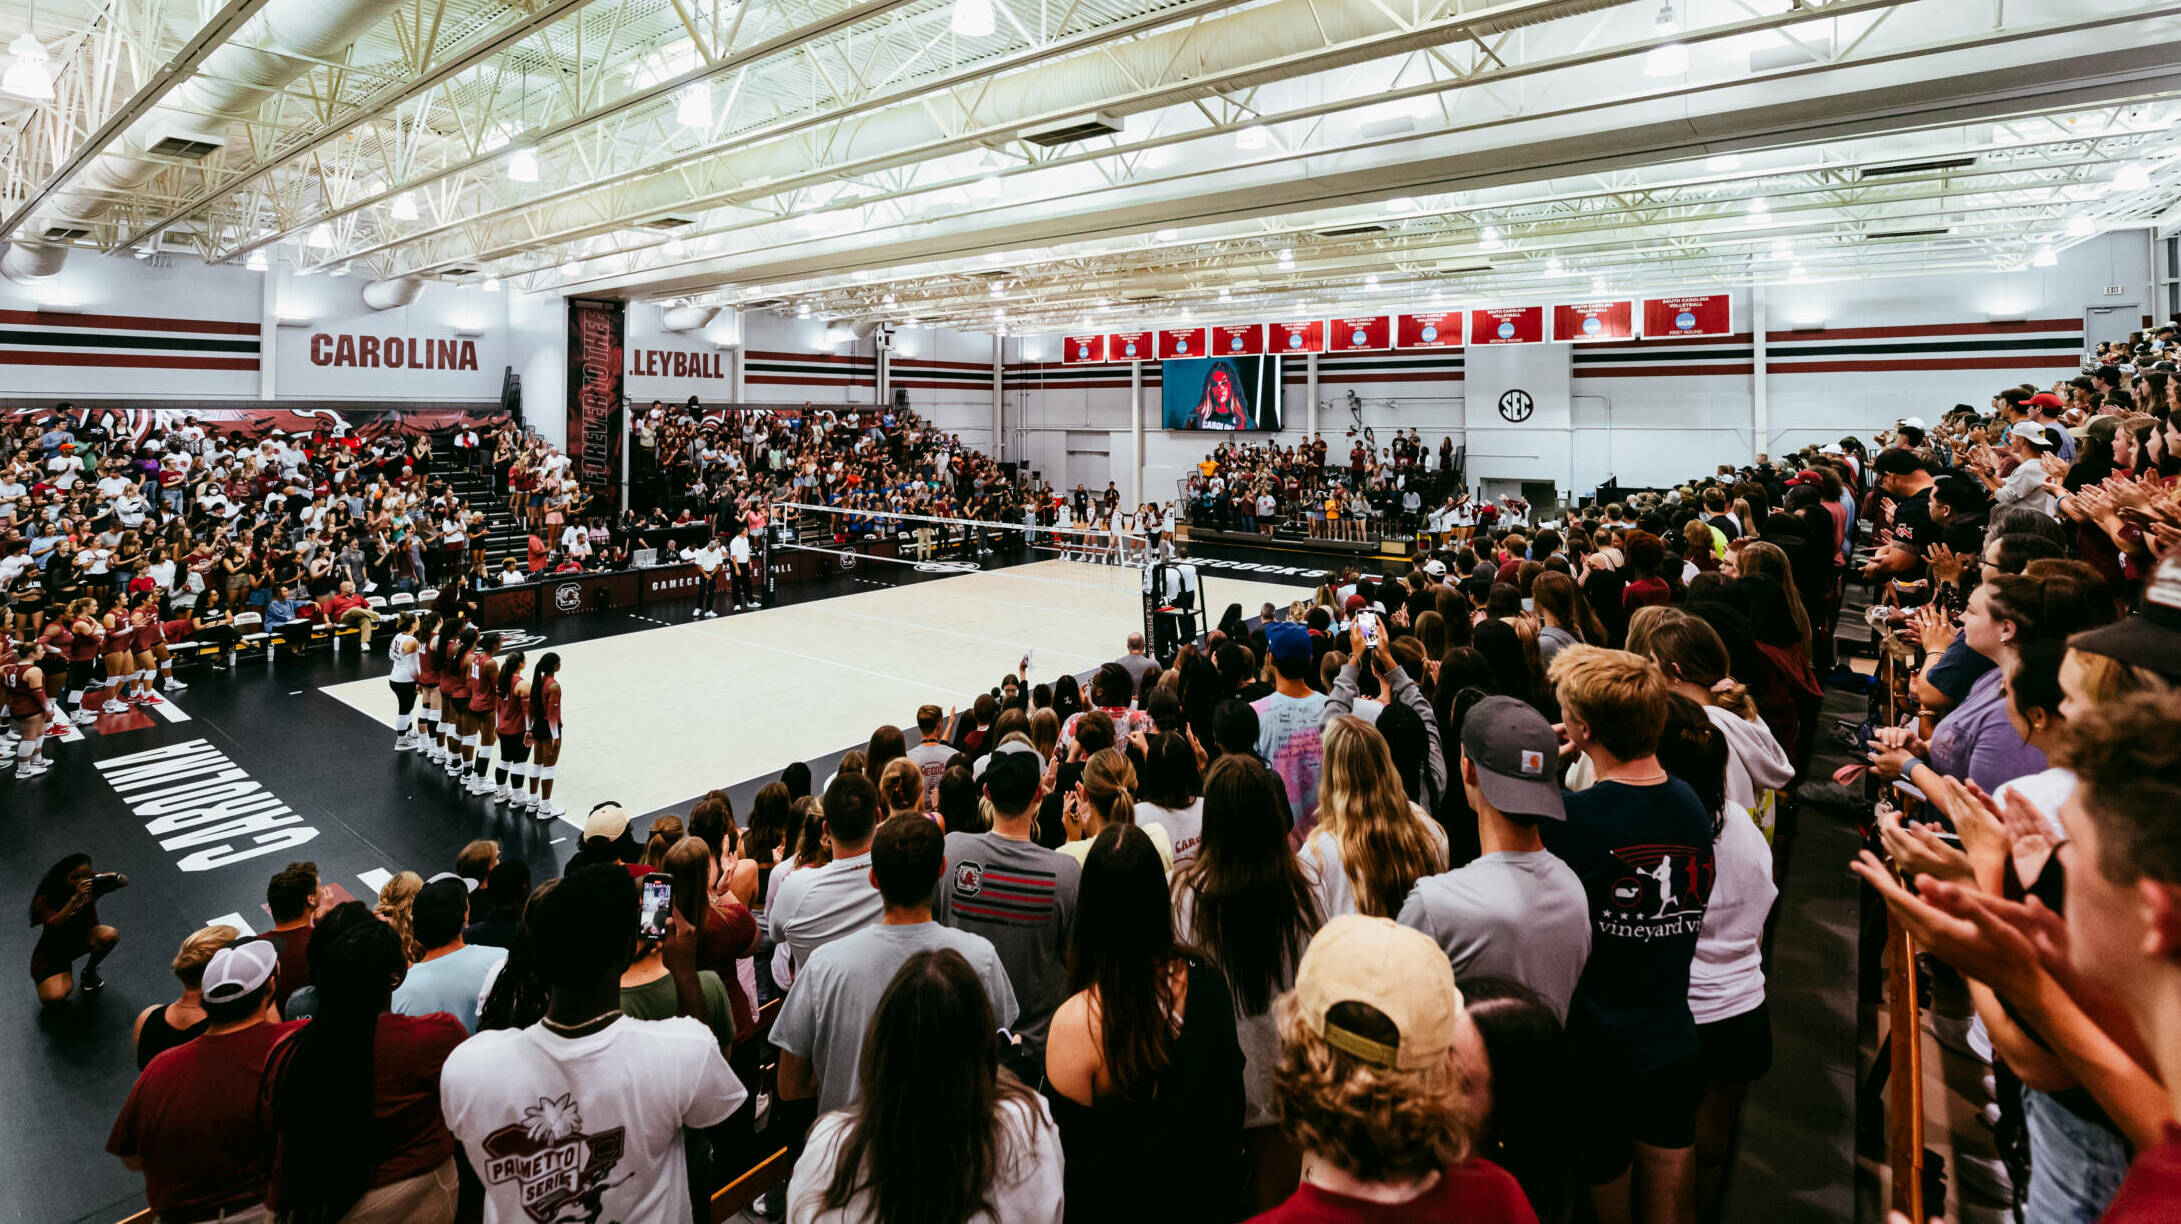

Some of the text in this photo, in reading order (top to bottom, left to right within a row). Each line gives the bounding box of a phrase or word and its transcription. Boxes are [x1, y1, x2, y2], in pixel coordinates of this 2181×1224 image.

[310, 332, 479, 371] CAROLINA
[629, 349, 725, 379] LEYBALL
[581, 308, 610, 486] FOREVER TO THEE
[1501, 391, 1531, 421] SEC
[93, 738, 321, 872] CAROLINA
[1599, 916, 1683, 943] vineyard
[493, 1147, 575, 1181] PALMETTO
